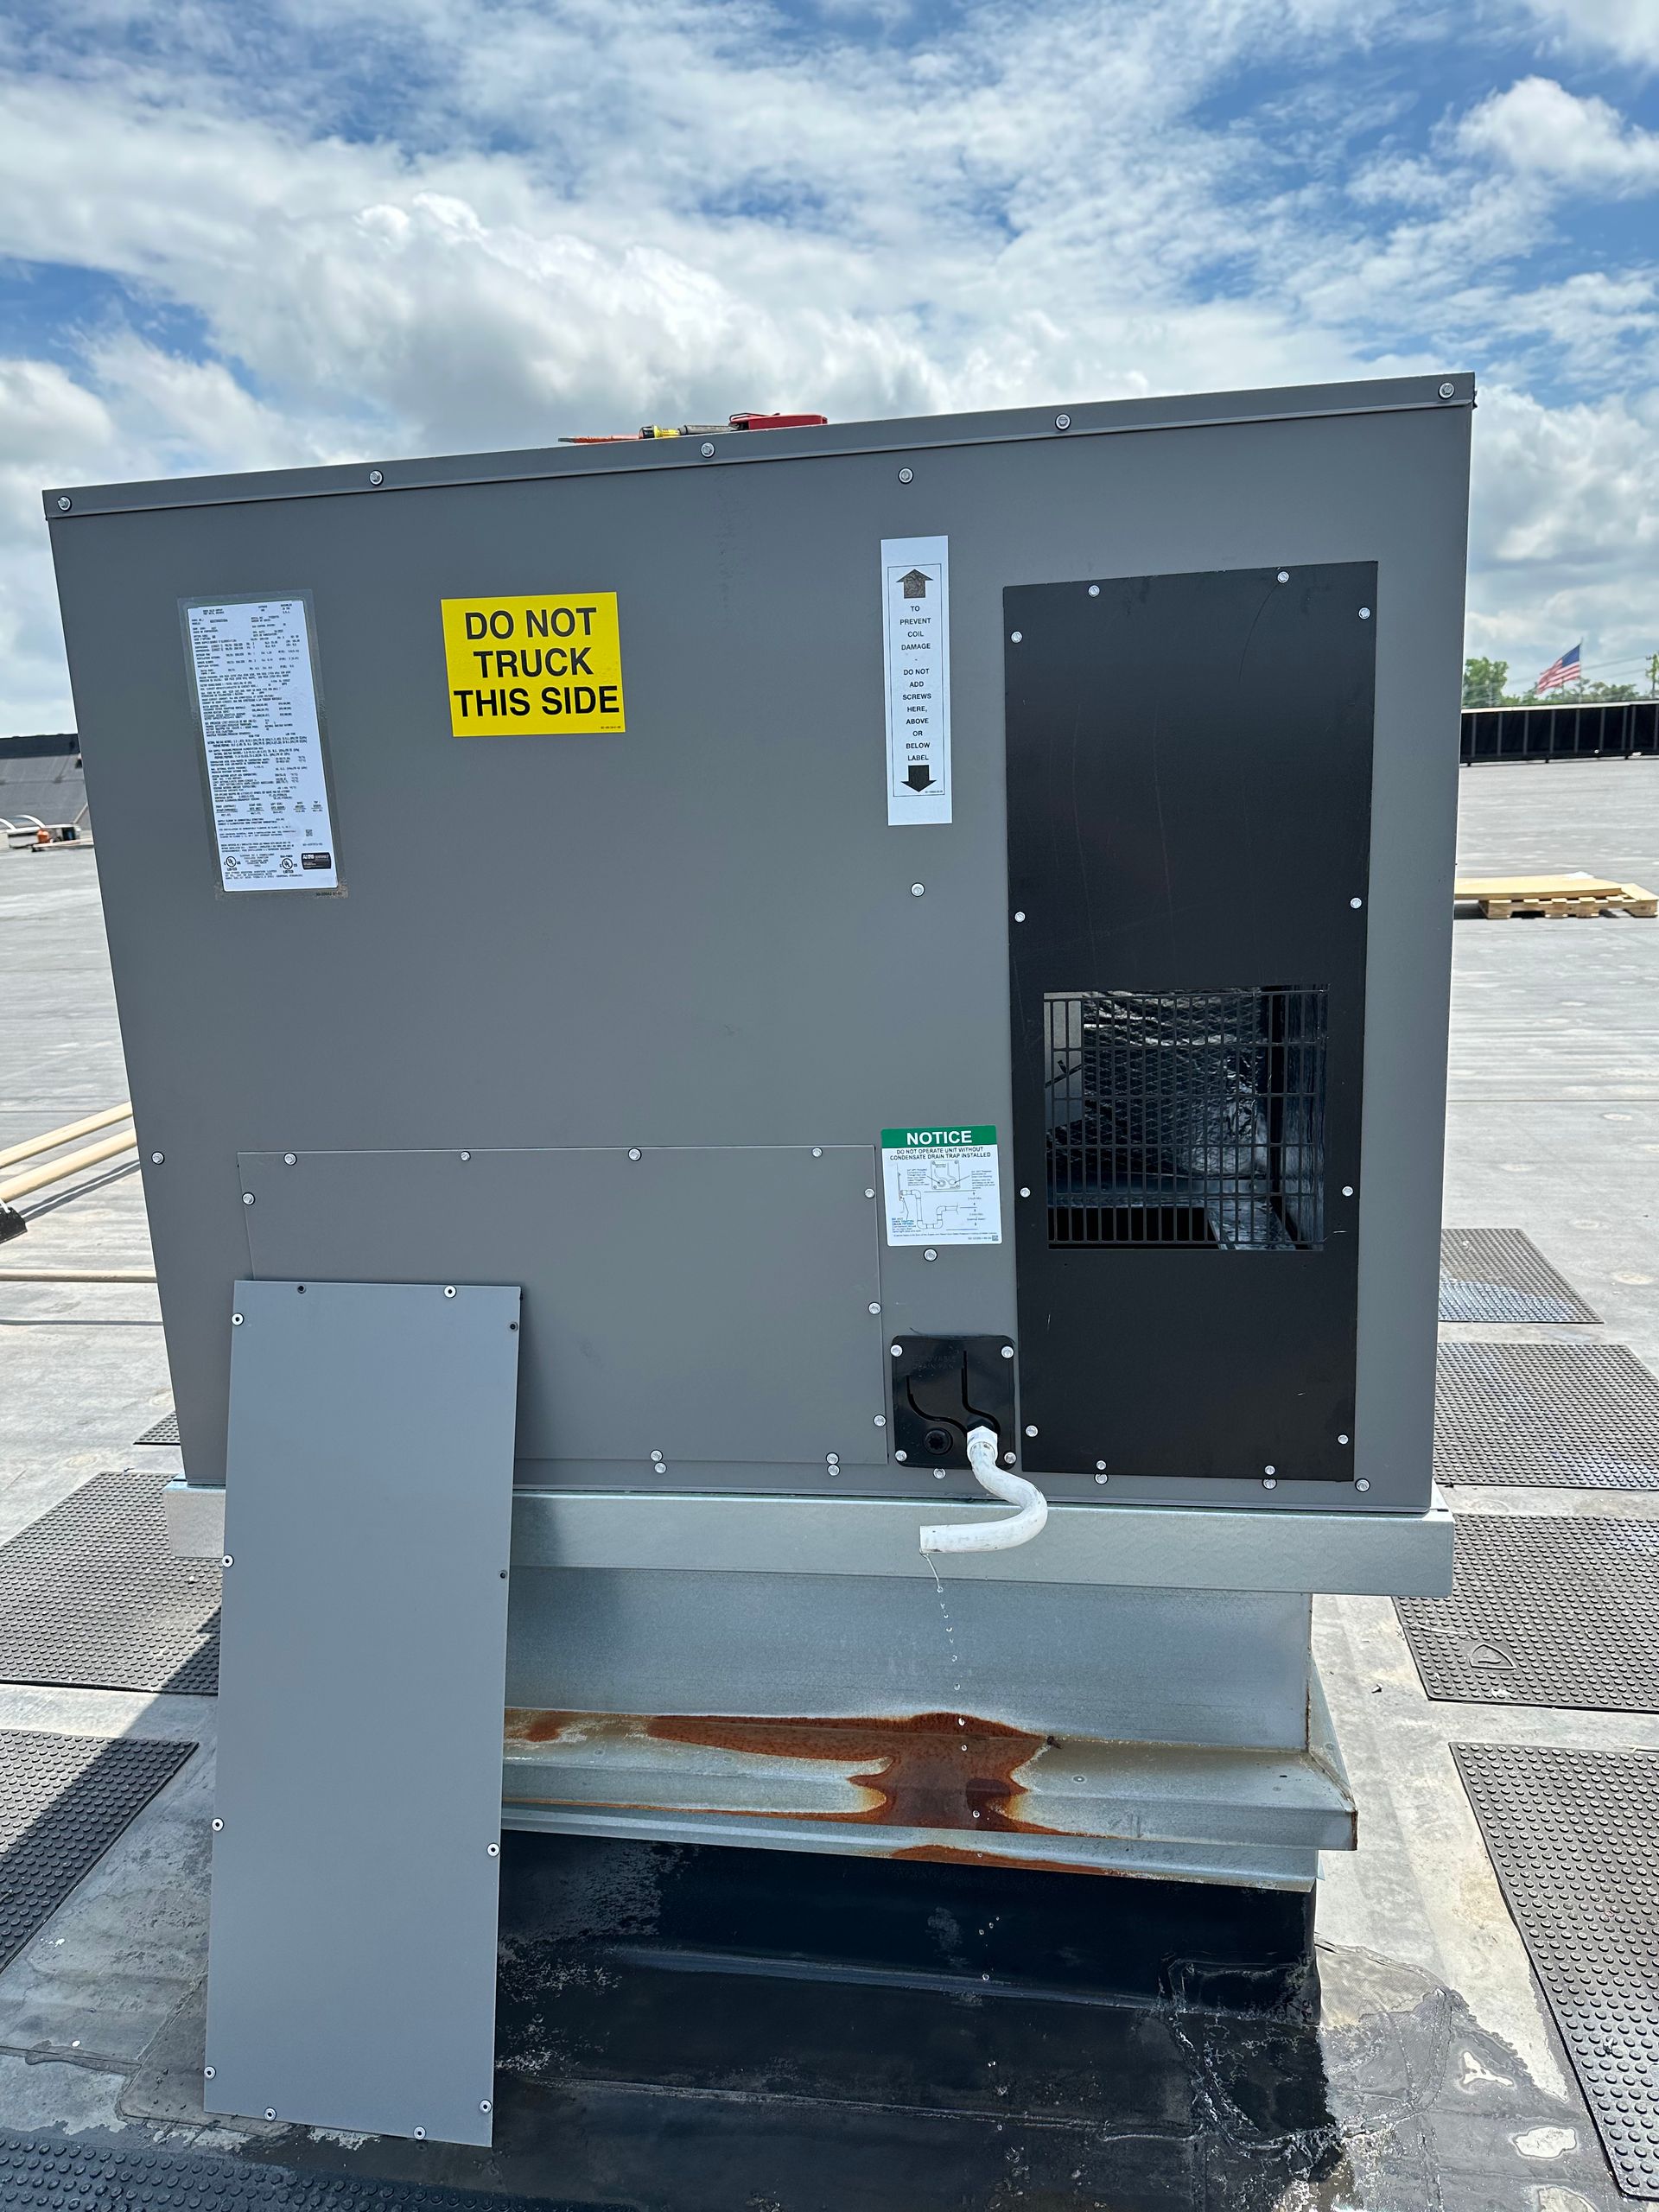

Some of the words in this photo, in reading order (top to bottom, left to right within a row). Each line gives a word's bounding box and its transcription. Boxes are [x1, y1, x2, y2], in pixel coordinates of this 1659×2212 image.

[465, 610, 514, 639] DO
[525, 607, 597, 638] NOT
[473, 647, 594, 678] TRUCK
[453, 688, 531, 717] THIS
[541, 685, 620, 715] SIDE
[906, 1130, 973, 1146] NOTICE
